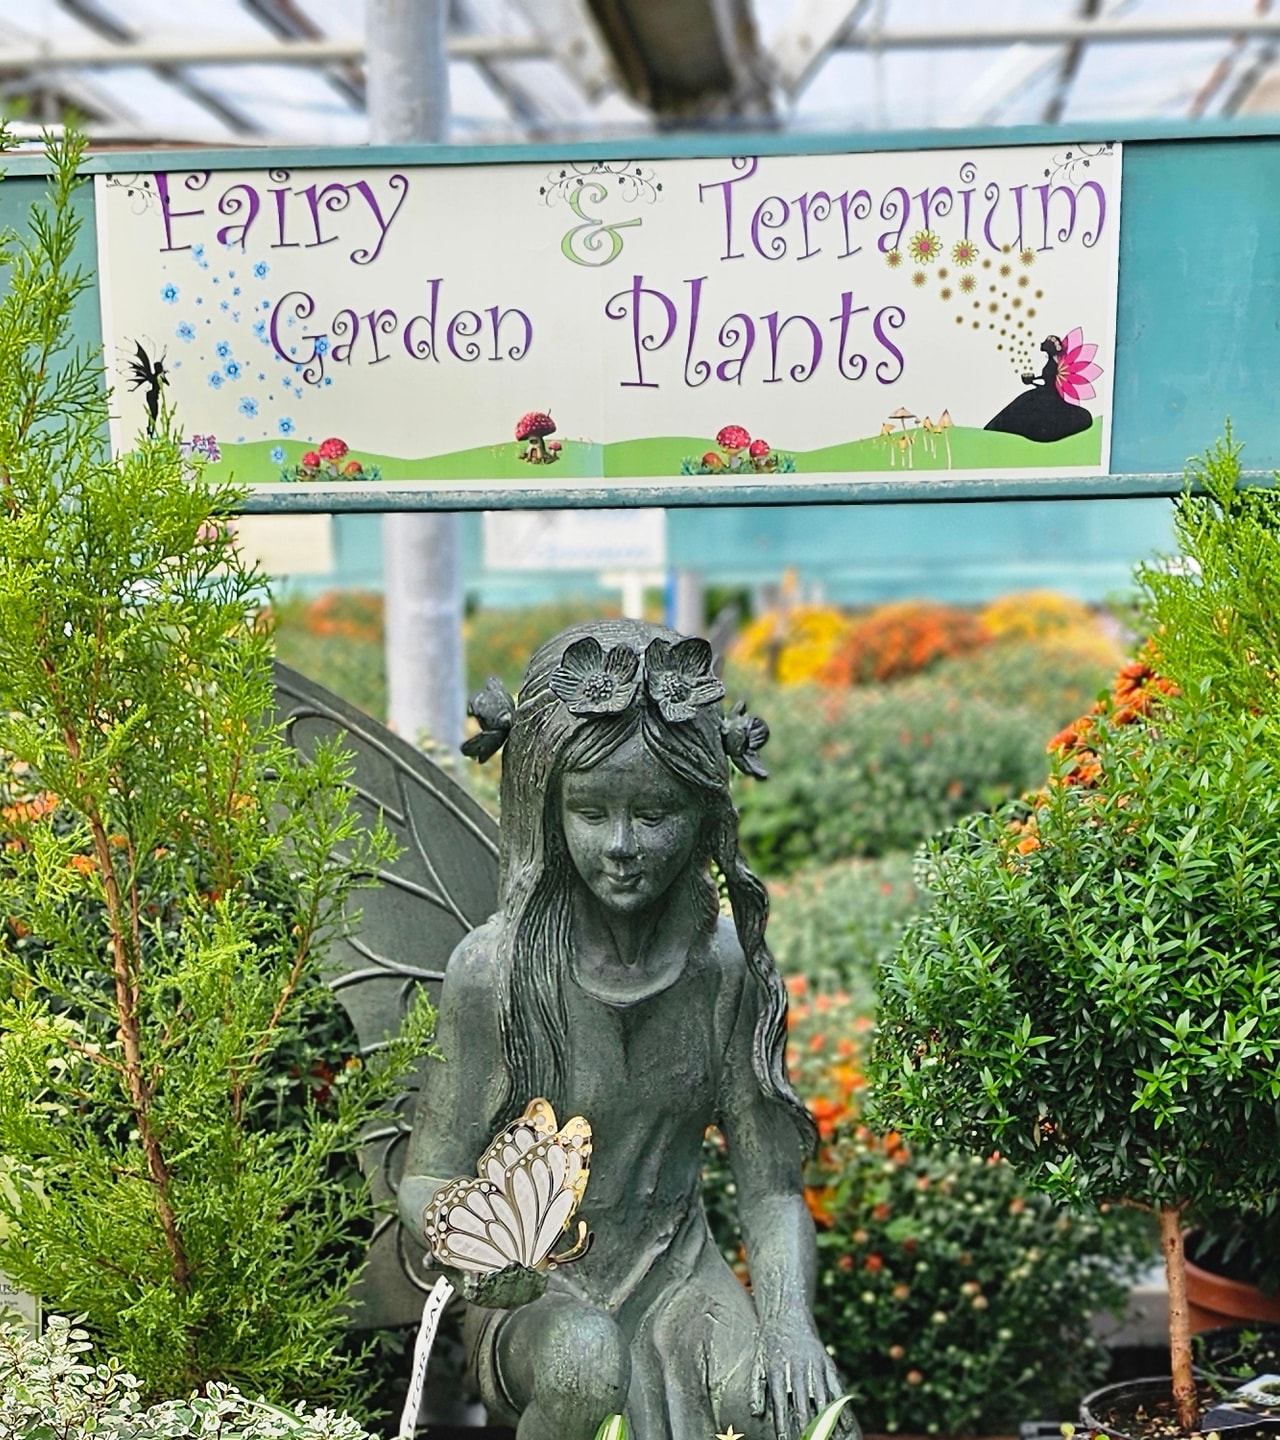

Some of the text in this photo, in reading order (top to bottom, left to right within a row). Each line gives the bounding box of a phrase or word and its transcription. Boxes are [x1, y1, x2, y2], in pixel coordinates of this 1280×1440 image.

[157, 158, 1108, 268] Fairy & Terrarium
[270, 275, 907, 389] Garden Plants
